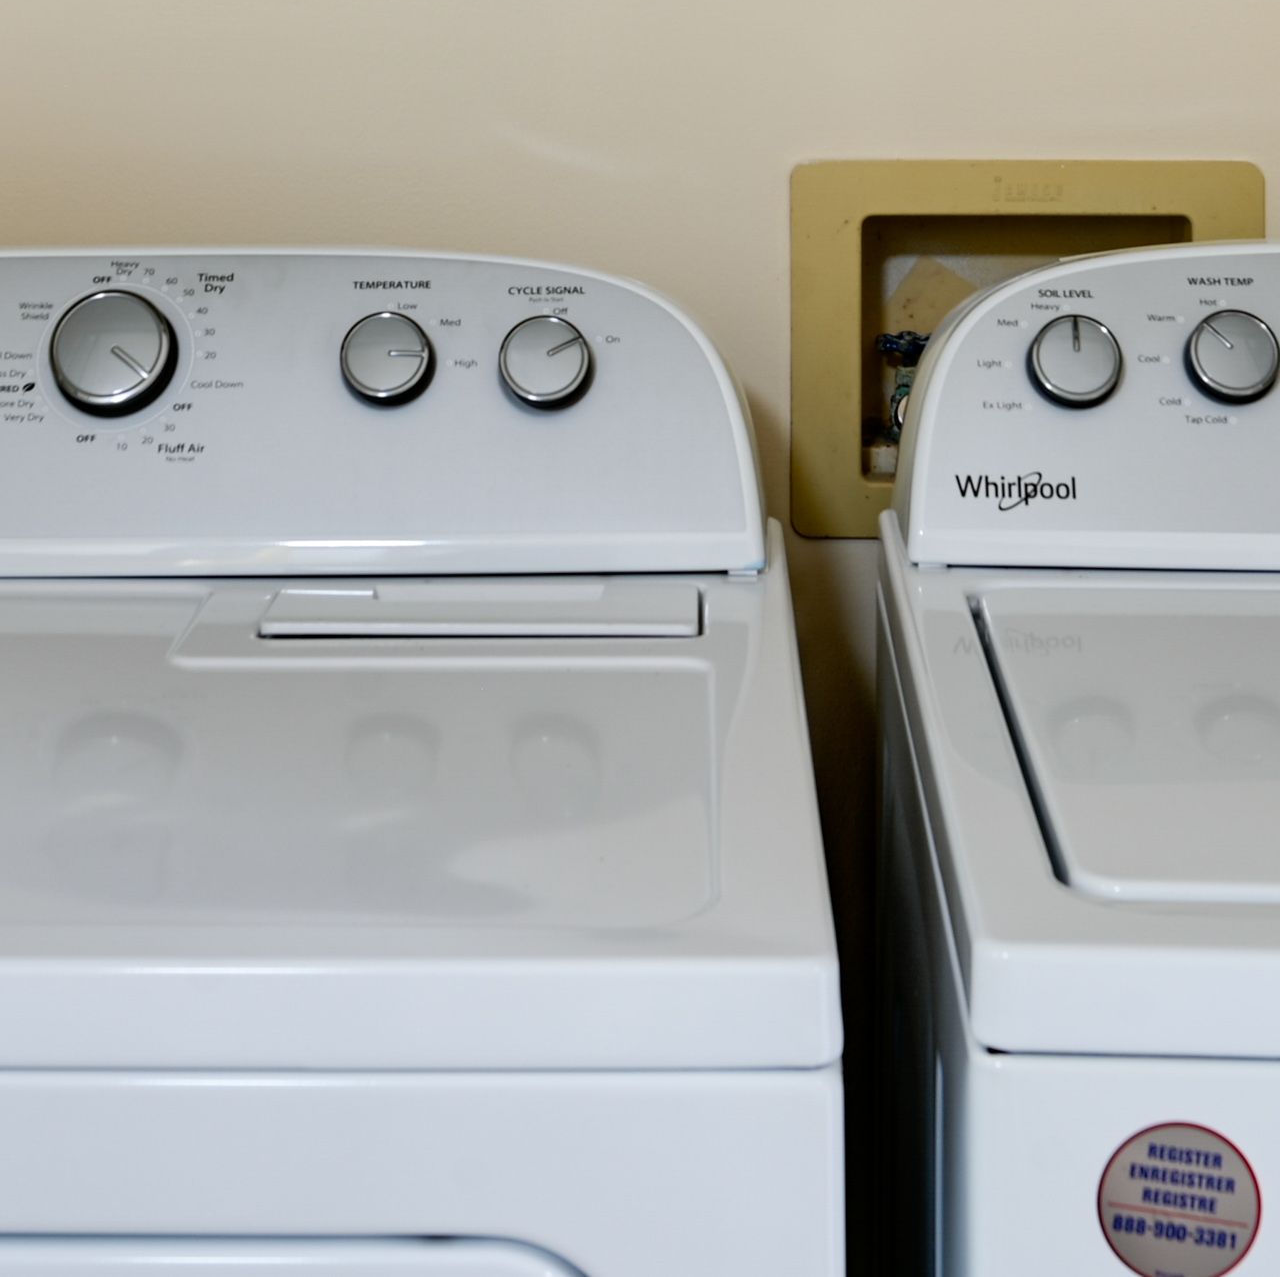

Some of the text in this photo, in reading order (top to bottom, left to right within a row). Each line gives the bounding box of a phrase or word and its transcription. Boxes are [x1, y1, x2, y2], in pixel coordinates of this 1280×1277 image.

[110, 260, 140, 270] Heavy
[116, 268, 135, 277] Dry
[144, 268, 155, 276] 70
[92, 276, 112, 284] OFF
[166, 277, 178, 285] 60
[197, 273, 234, 283] Timed
[1187, 277, 1254, 288] WASH TEMP
[204, 284, 226, 294] Dry
[353, 280, 431, 290] TEMPERATURE
[508, 285, 587, 295] CYCLE SIGNAL
[1038, 289, 1094, 299] SOIL LEVEL
[19, 302, 53, 310] Wrinkle
[397, 302, 417, 311] Low
[1031, 302, 1061, 312] Heavy
[1199, 298, 1217, 307] Hot
[21, 312, 50, 320] Shield
[196, 307, 208, 315] 40
[553, 307, 568, 315] Off
[440, 318, 461, 327] Med
[997, 318, 1018, 327] Med
[1147, 314, 1175, 323] Warm
[205, 328, 216, 336] 30
[605, 335, 621, 343] On
[4, 351, 33, 360] Down
[205, 351, 217, 360] 20
[1138, 354, 1161, 363] Cool
[454, 358, 478, 369] High
[977, 359, 1002, 369] Light
[9, 369, 27, 379] Dry
[190, 380, 244, 389] Cool Down
[17, 400, 34, 409] Dry
[982, 401, 1022, 412] Ex Light
[1159, 397, 1182, 406] Cold
[172, 402, 193, 412] OFF
[4, 413, 44, 423] Very Dry
[1185, 415, 1227, 426] Tap Cold
[76, 434, 97, 444] OFF
[157, 443, 205, 453] Fluff Air
[955, 472, 1077, 511] Whirlpool
[1148, 1143, 1222, 1170] REGISTER
[1129, 1163, 1236, 1194] ENREGISTRER
[1142, 1187, 1217, 1214] REGISTRE
[1112, 1214, 1237, 1250] 888-900-3381
